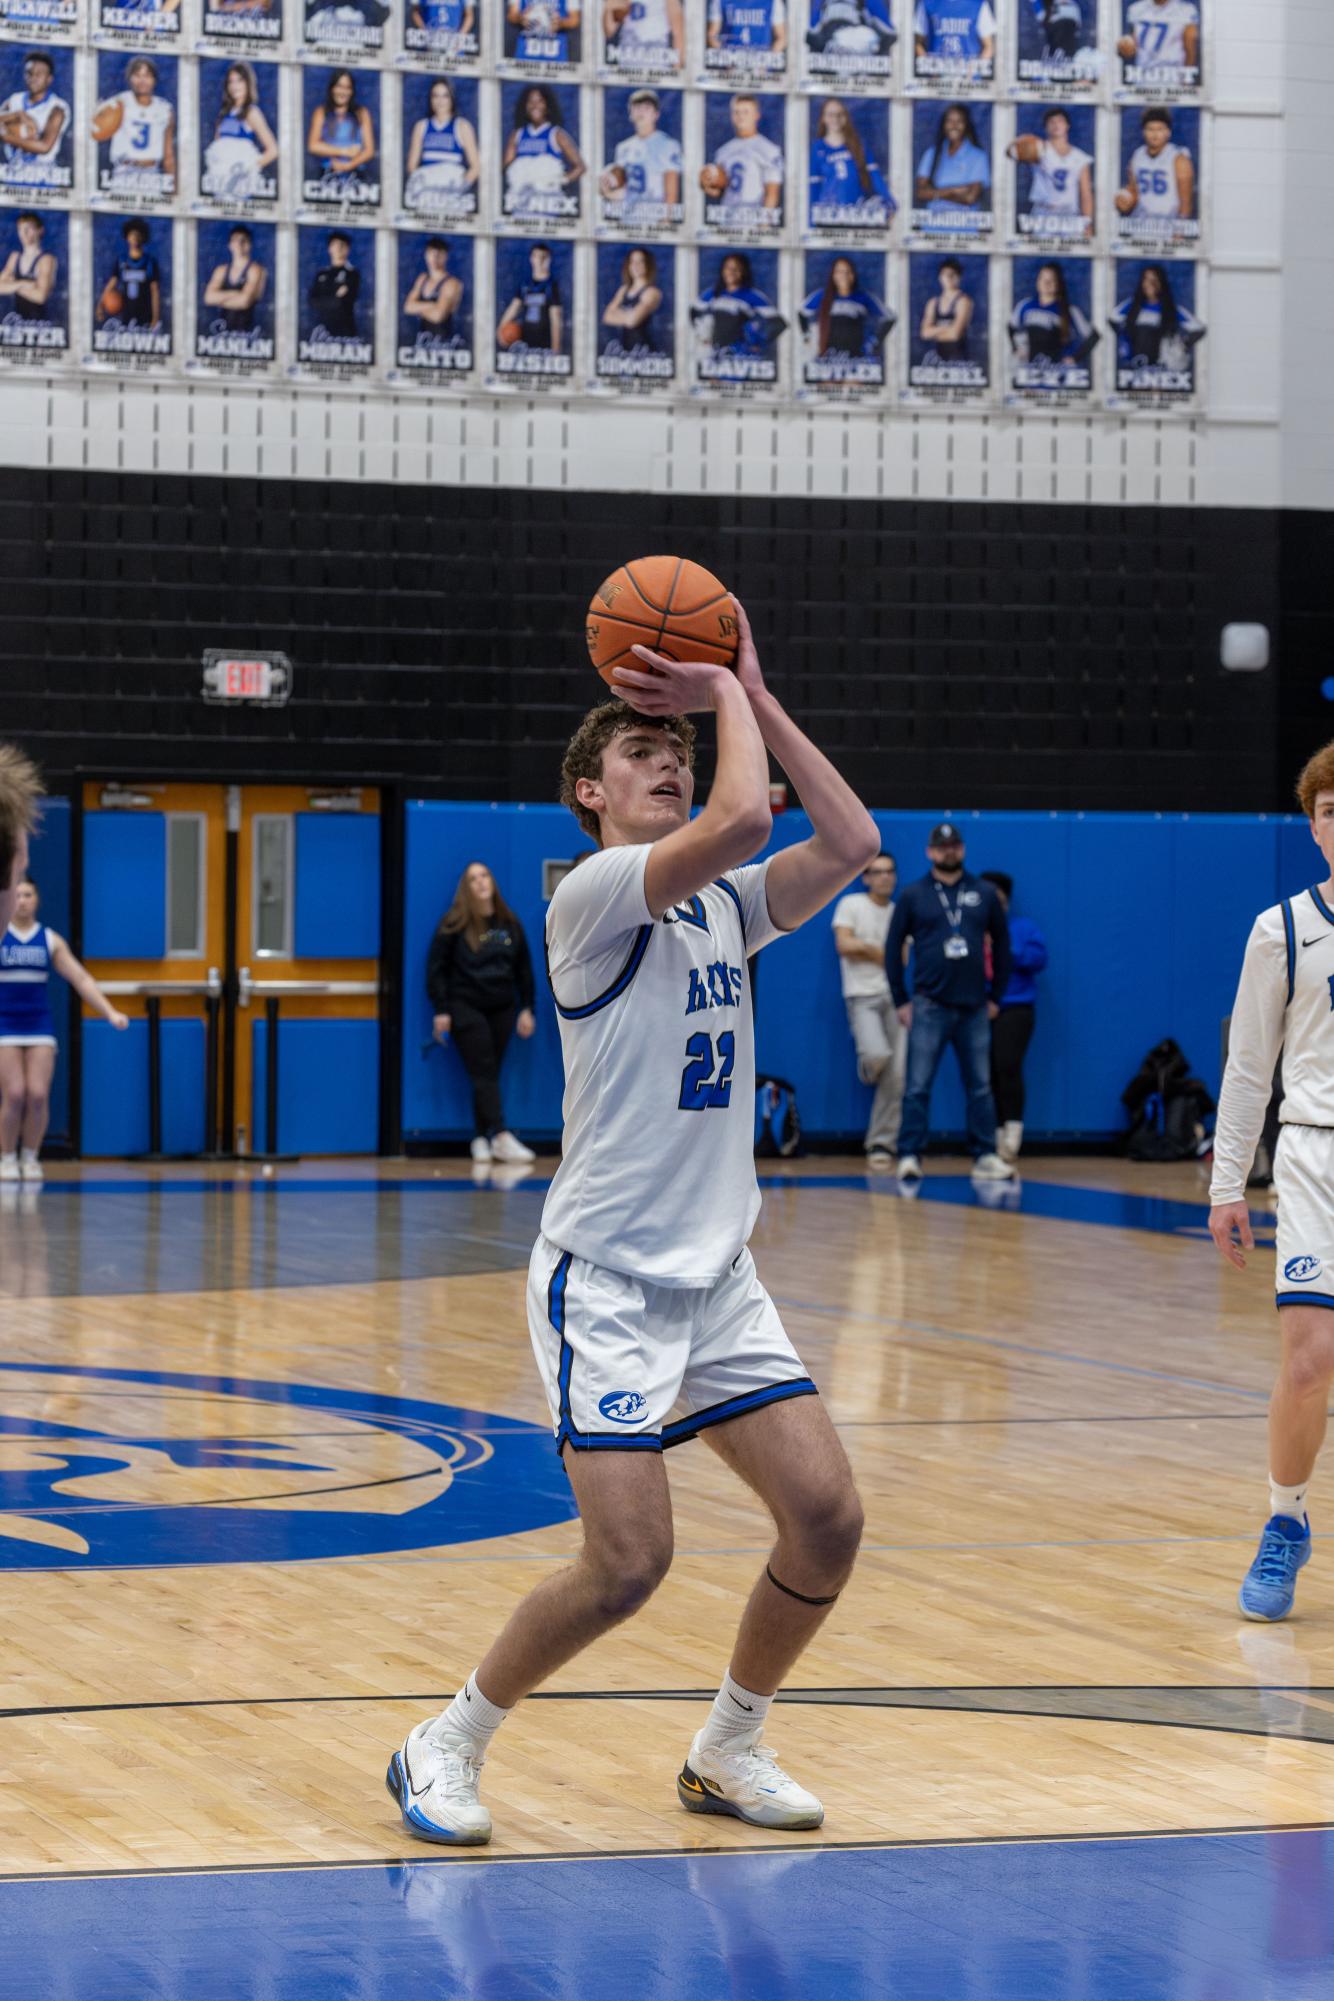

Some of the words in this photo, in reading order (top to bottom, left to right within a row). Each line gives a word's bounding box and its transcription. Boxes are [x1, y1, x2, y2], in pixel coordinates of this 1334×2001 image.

[304, 180, 380, 203] CHAN
[94, 330, 172, 353] BROWN
[702, 359, 778, 380] DAVIS
[226, 663, 264, 694] EXIT
[678, 1030, 735, 1111] 22
